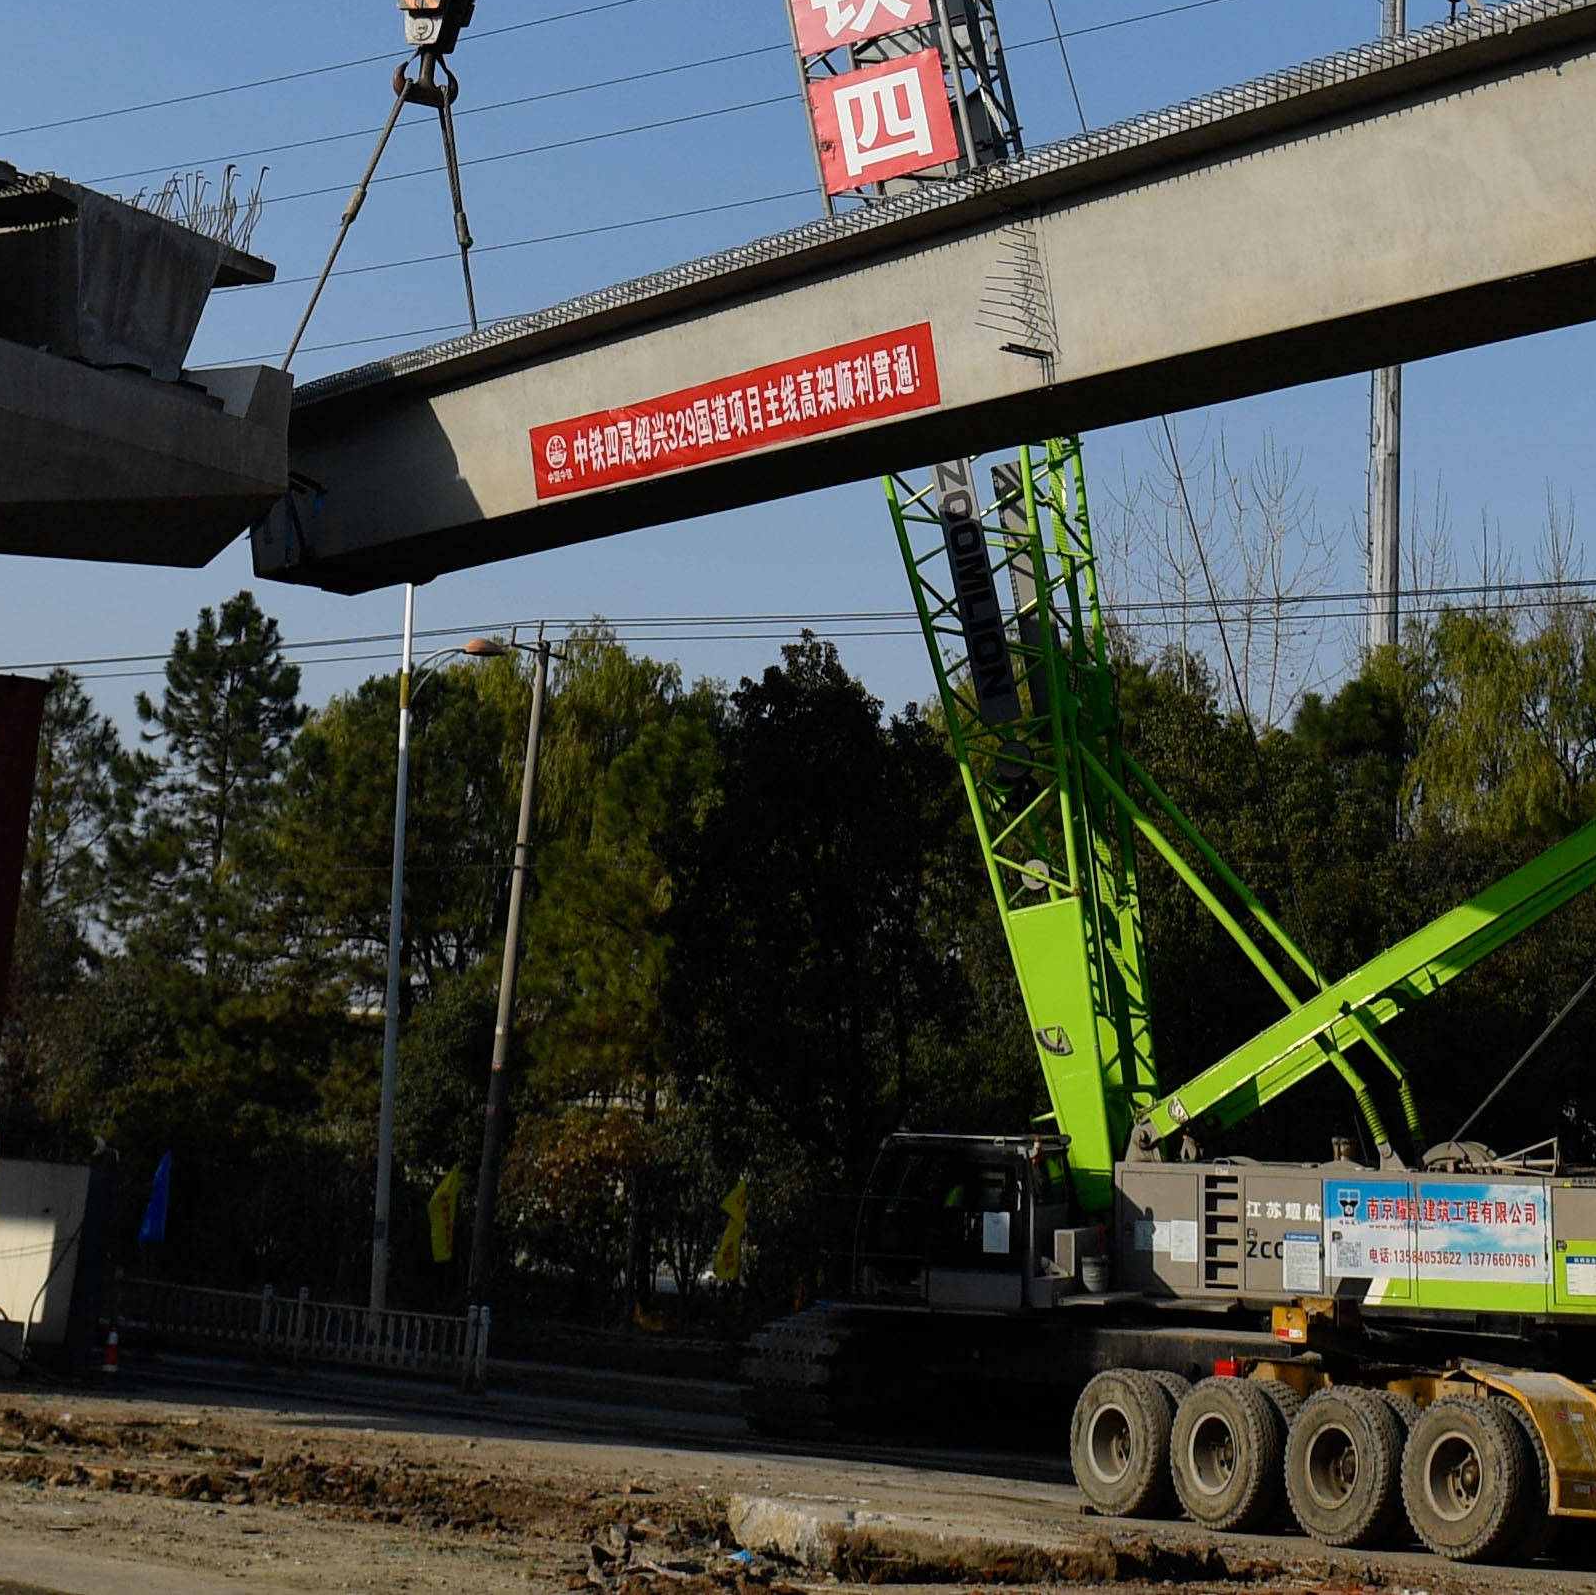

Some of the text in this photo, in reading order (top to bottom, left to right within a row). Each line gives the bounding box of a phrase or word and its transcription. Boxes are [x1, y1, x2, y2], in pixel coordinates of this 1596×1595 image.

[573, 345, 922, 476] 中铁四局绍兴329国道项目主线高架顺利贯通!
[935, 459, 1012, 699] ZOOMLION
[1246, 1200, 1322, 1222] 江苏耀航
[1366, 1196, 1537, 1226] 南京耀航建筑工程有限公司
[1467, 1252, 1537, 1269] 13776607961
